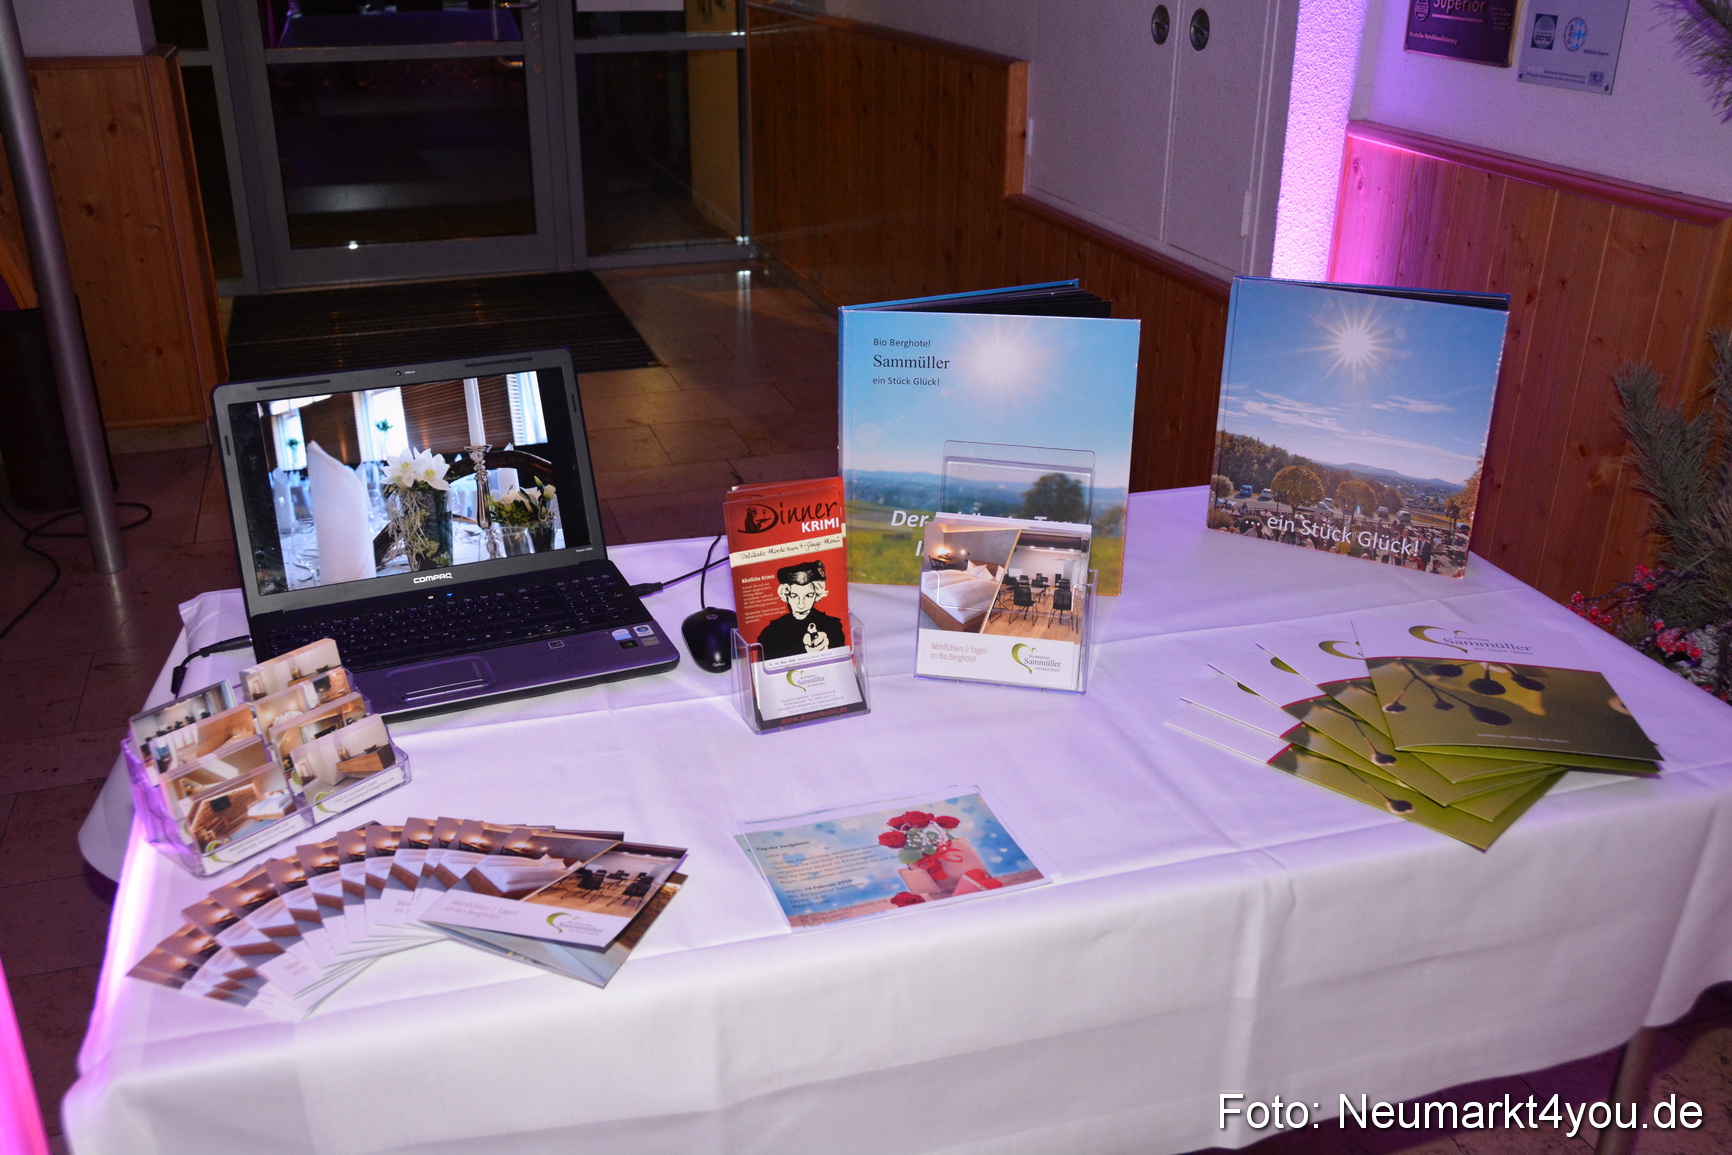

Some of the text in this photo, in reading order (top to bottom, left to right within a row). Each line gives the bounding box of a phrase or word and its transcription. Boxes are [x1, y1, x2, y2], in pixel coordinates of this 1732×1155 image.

[1433, 0, 1486, 13] Superior
[873, 338, 931, 348] Bio Berghotel
[873, 355, 950, 370] Sammüller
[872, 377, 940, 386] ein Stück Glück!
[737, 502, 837, 534] Dinner
[891, 510, 930, 528] Der
[801, 517, 840, 533] KRIMI
[1267, 516, 1296, 532] ein
[1300, 520, 1352, 544] Stück
[1357, 531, 1420, 557] Glück!
[413, 572, 453, 584] COMPAQ
[931, 642, 964, 653] Wohlfühlen
[970, 645, 988, 655] tagen
[1443, 637, 1532, 652] Sammüller
[930, 652, 977, 664] im Bio Berghotel
[1024, 657, 1062, 668] Sammüller
